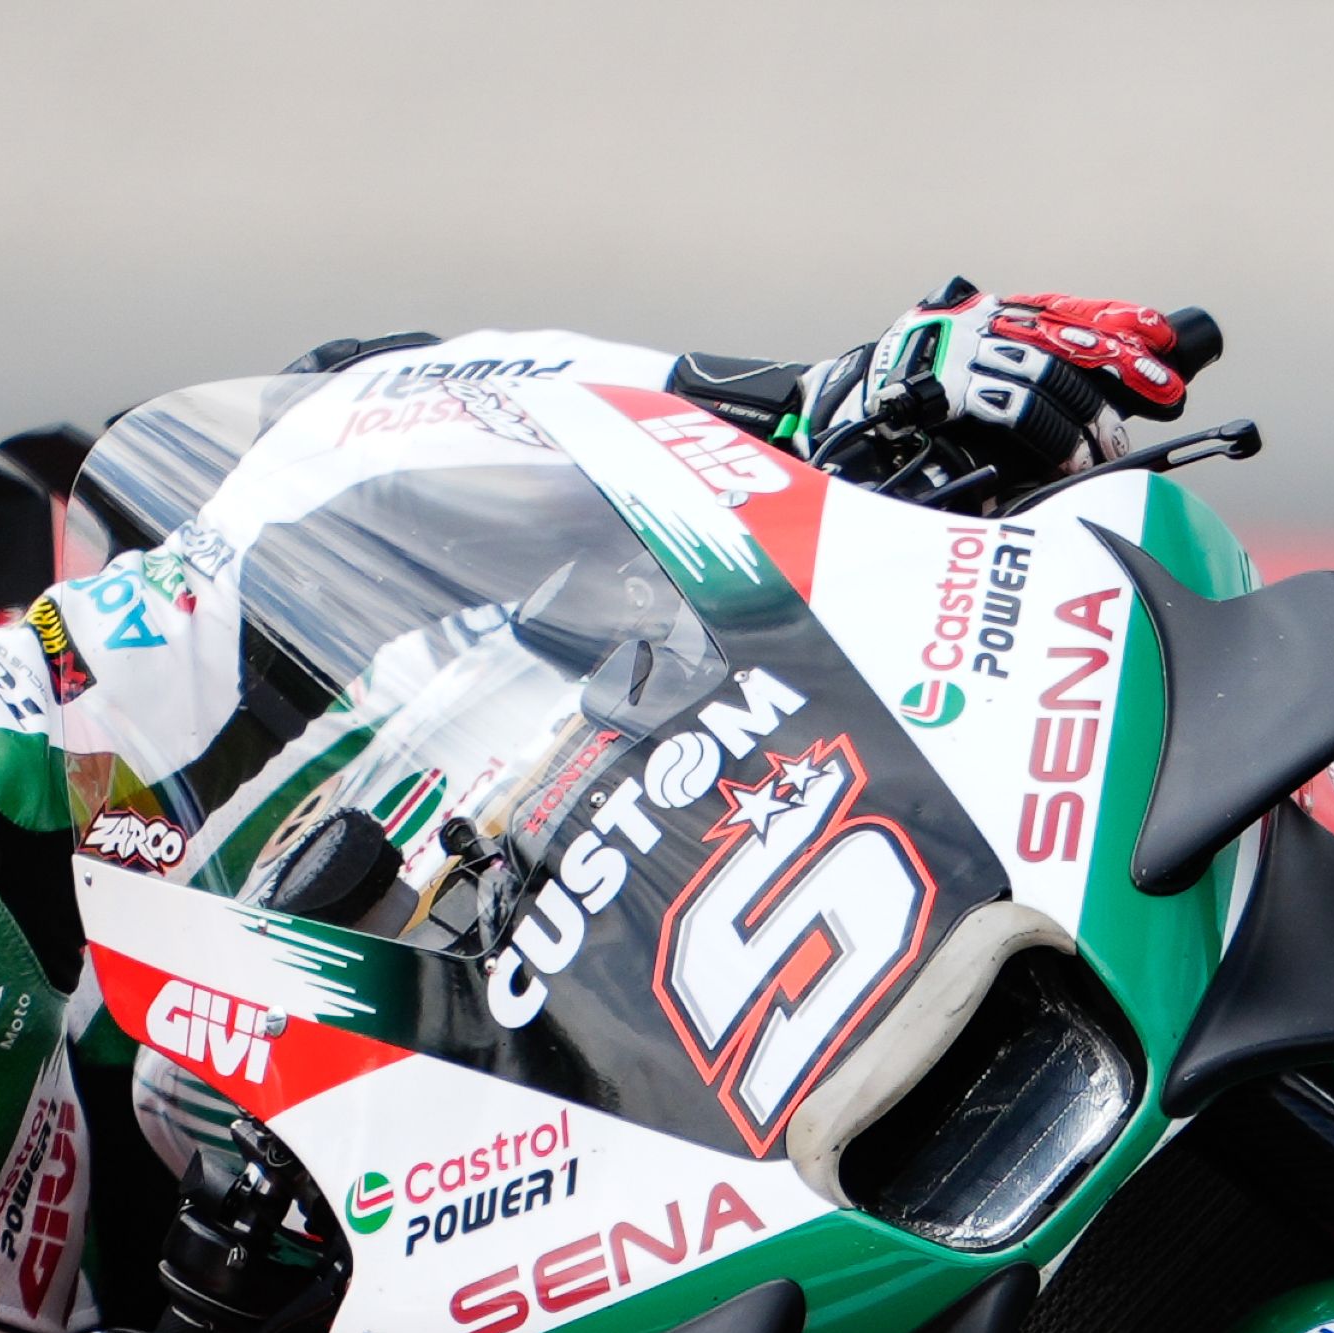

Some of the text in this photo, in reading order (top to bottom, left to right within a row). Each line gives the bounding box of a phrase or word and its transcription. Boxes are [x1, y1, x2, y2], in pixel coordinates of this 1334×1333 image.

[639, 413, 791, 494] GIVI
[921, 526, 988, 671] Castrol
[972, 524, 1036, 679] POWER1
[1017, 588, 1122, 863] SENA
[524, 728, 621, 836] HONDA
[83, 812, 184, 870] ZARCO
[487, 667, 810, 1029] CUSTOM
[0, 993, 32, 1051] Moto
[146, 979, 271, 1083] GIVI
[19, 1100, 76, 1319] GIVI
[404, 1109, 569, 1205] Castrol
[405, 1157, 578, 1257] POWER1
